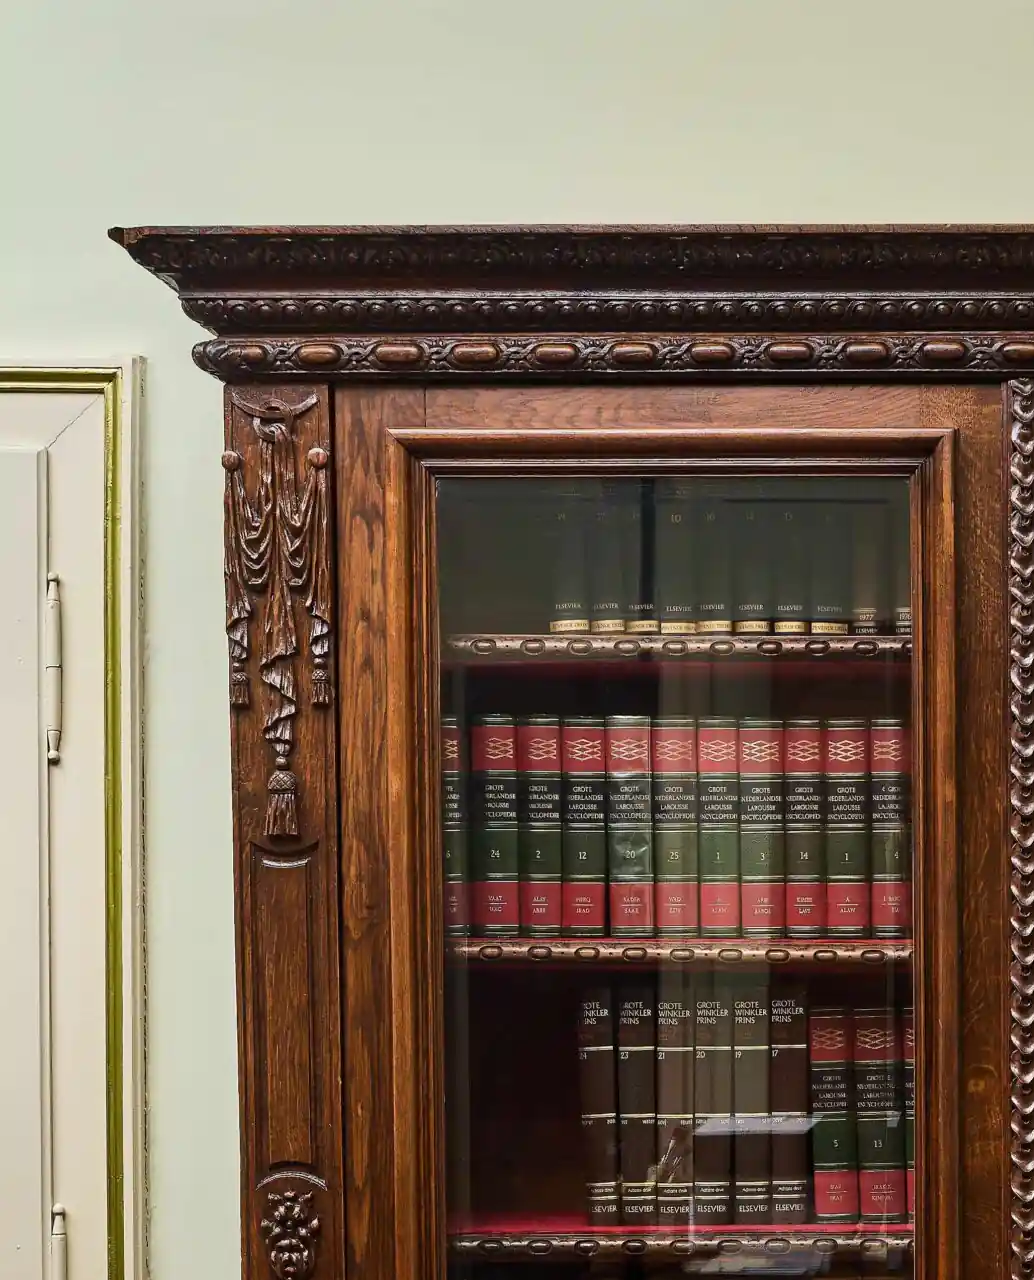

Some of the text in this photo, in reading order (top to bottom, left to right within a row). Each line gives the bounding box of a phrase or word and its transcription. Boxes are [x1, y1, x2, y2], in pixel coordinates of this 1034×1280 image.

[671, 514, 681, 523] 10
[490, 850, 500, 858] 24
[658, 1002, 682, 1010] GROTE
[697, 1001, 720, 1009] GROTE
[735, 1001, 758, 1009] GROTE
[772, 1000, 795, 1008] GROTE
[620, 1009, 651, 1017] WINKLER
[735, 1008, 767, 1016] WINKLER
[772, 1007, 804, 1015] WINKLER
[620, 1017, 639, 1025] PRINS
[772, 1015, 791, 1023] PRINS
[696, 1051, 705, 1059] 20
[874, 1140, 882, 1148] 13
